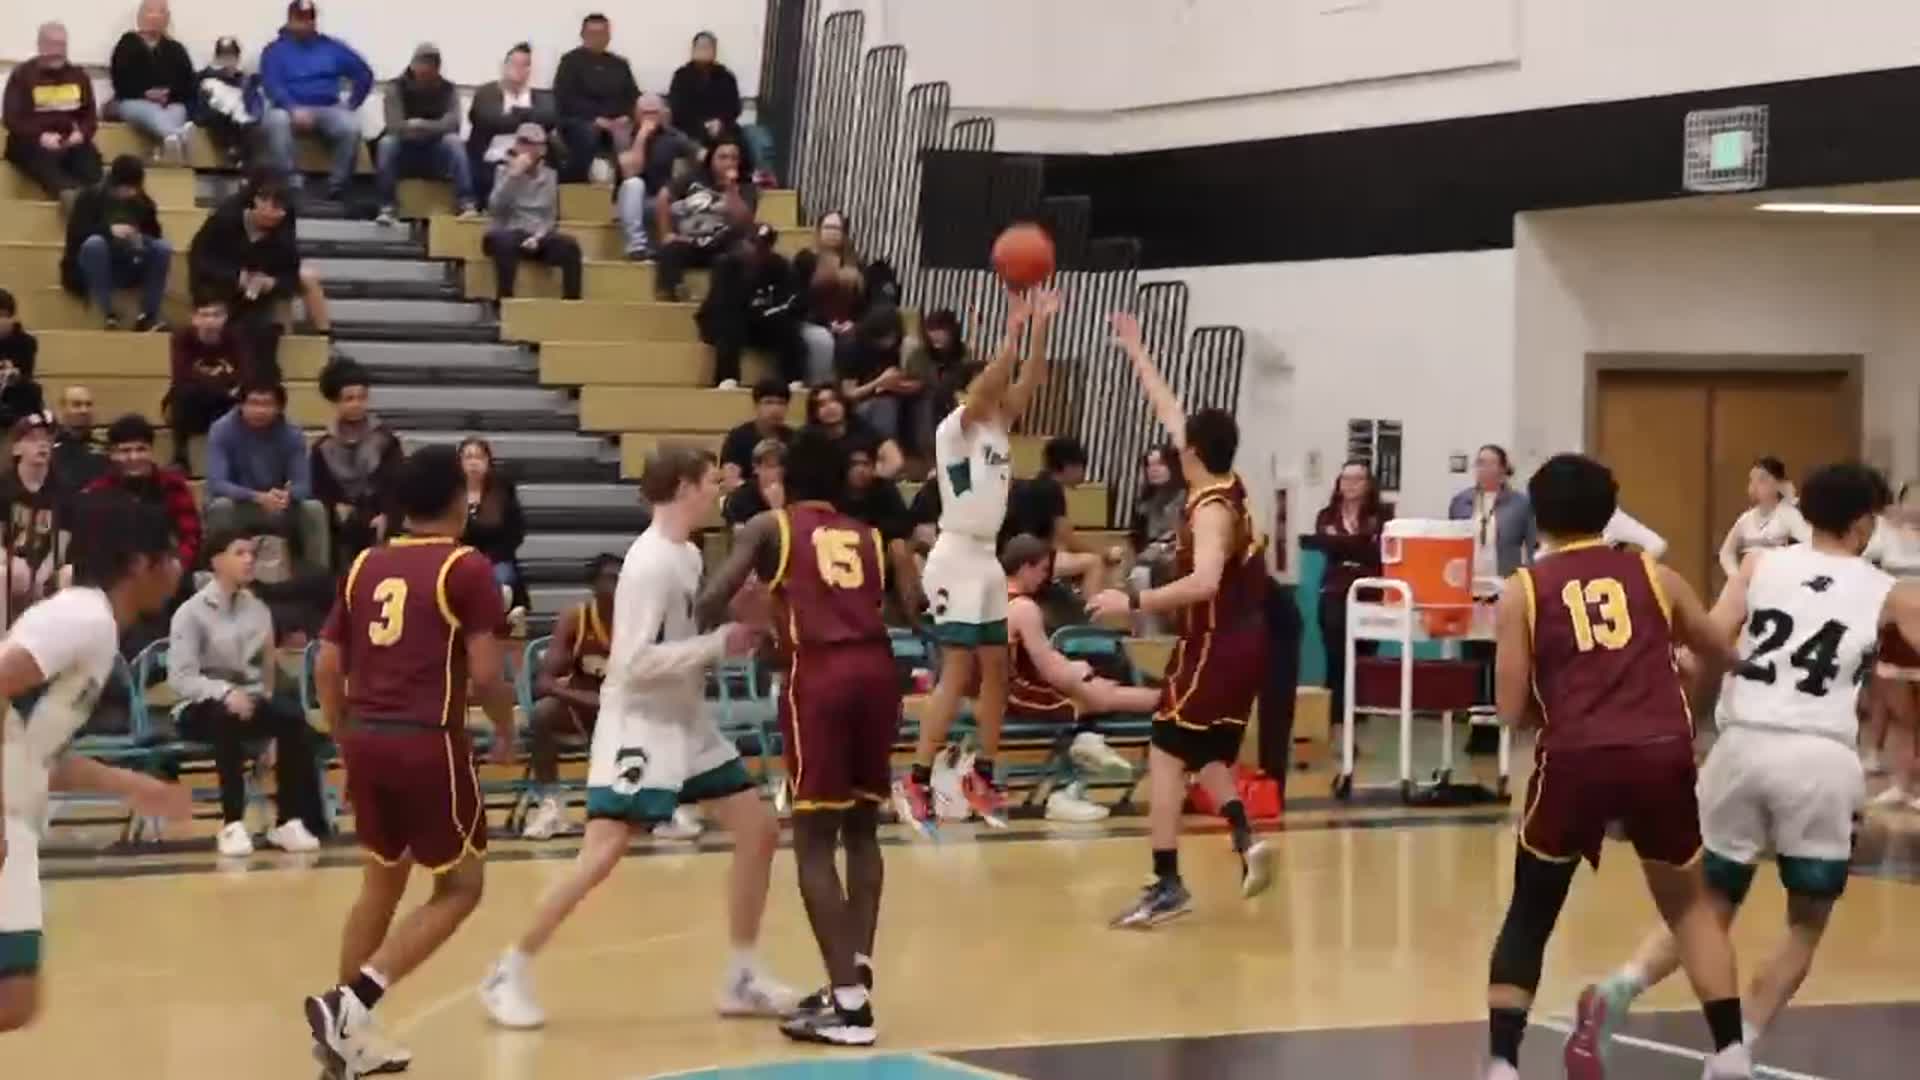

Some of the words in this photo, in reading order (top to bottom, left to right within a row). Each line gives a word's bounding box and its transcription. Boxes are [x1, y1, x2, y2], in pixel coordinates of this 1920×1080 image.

[812, 526, 865, 589] 15
[368, 577, 408, 647] 3
[1561, 577, 1633, 652] 13
[1734, 608, 1848, 697] 24
